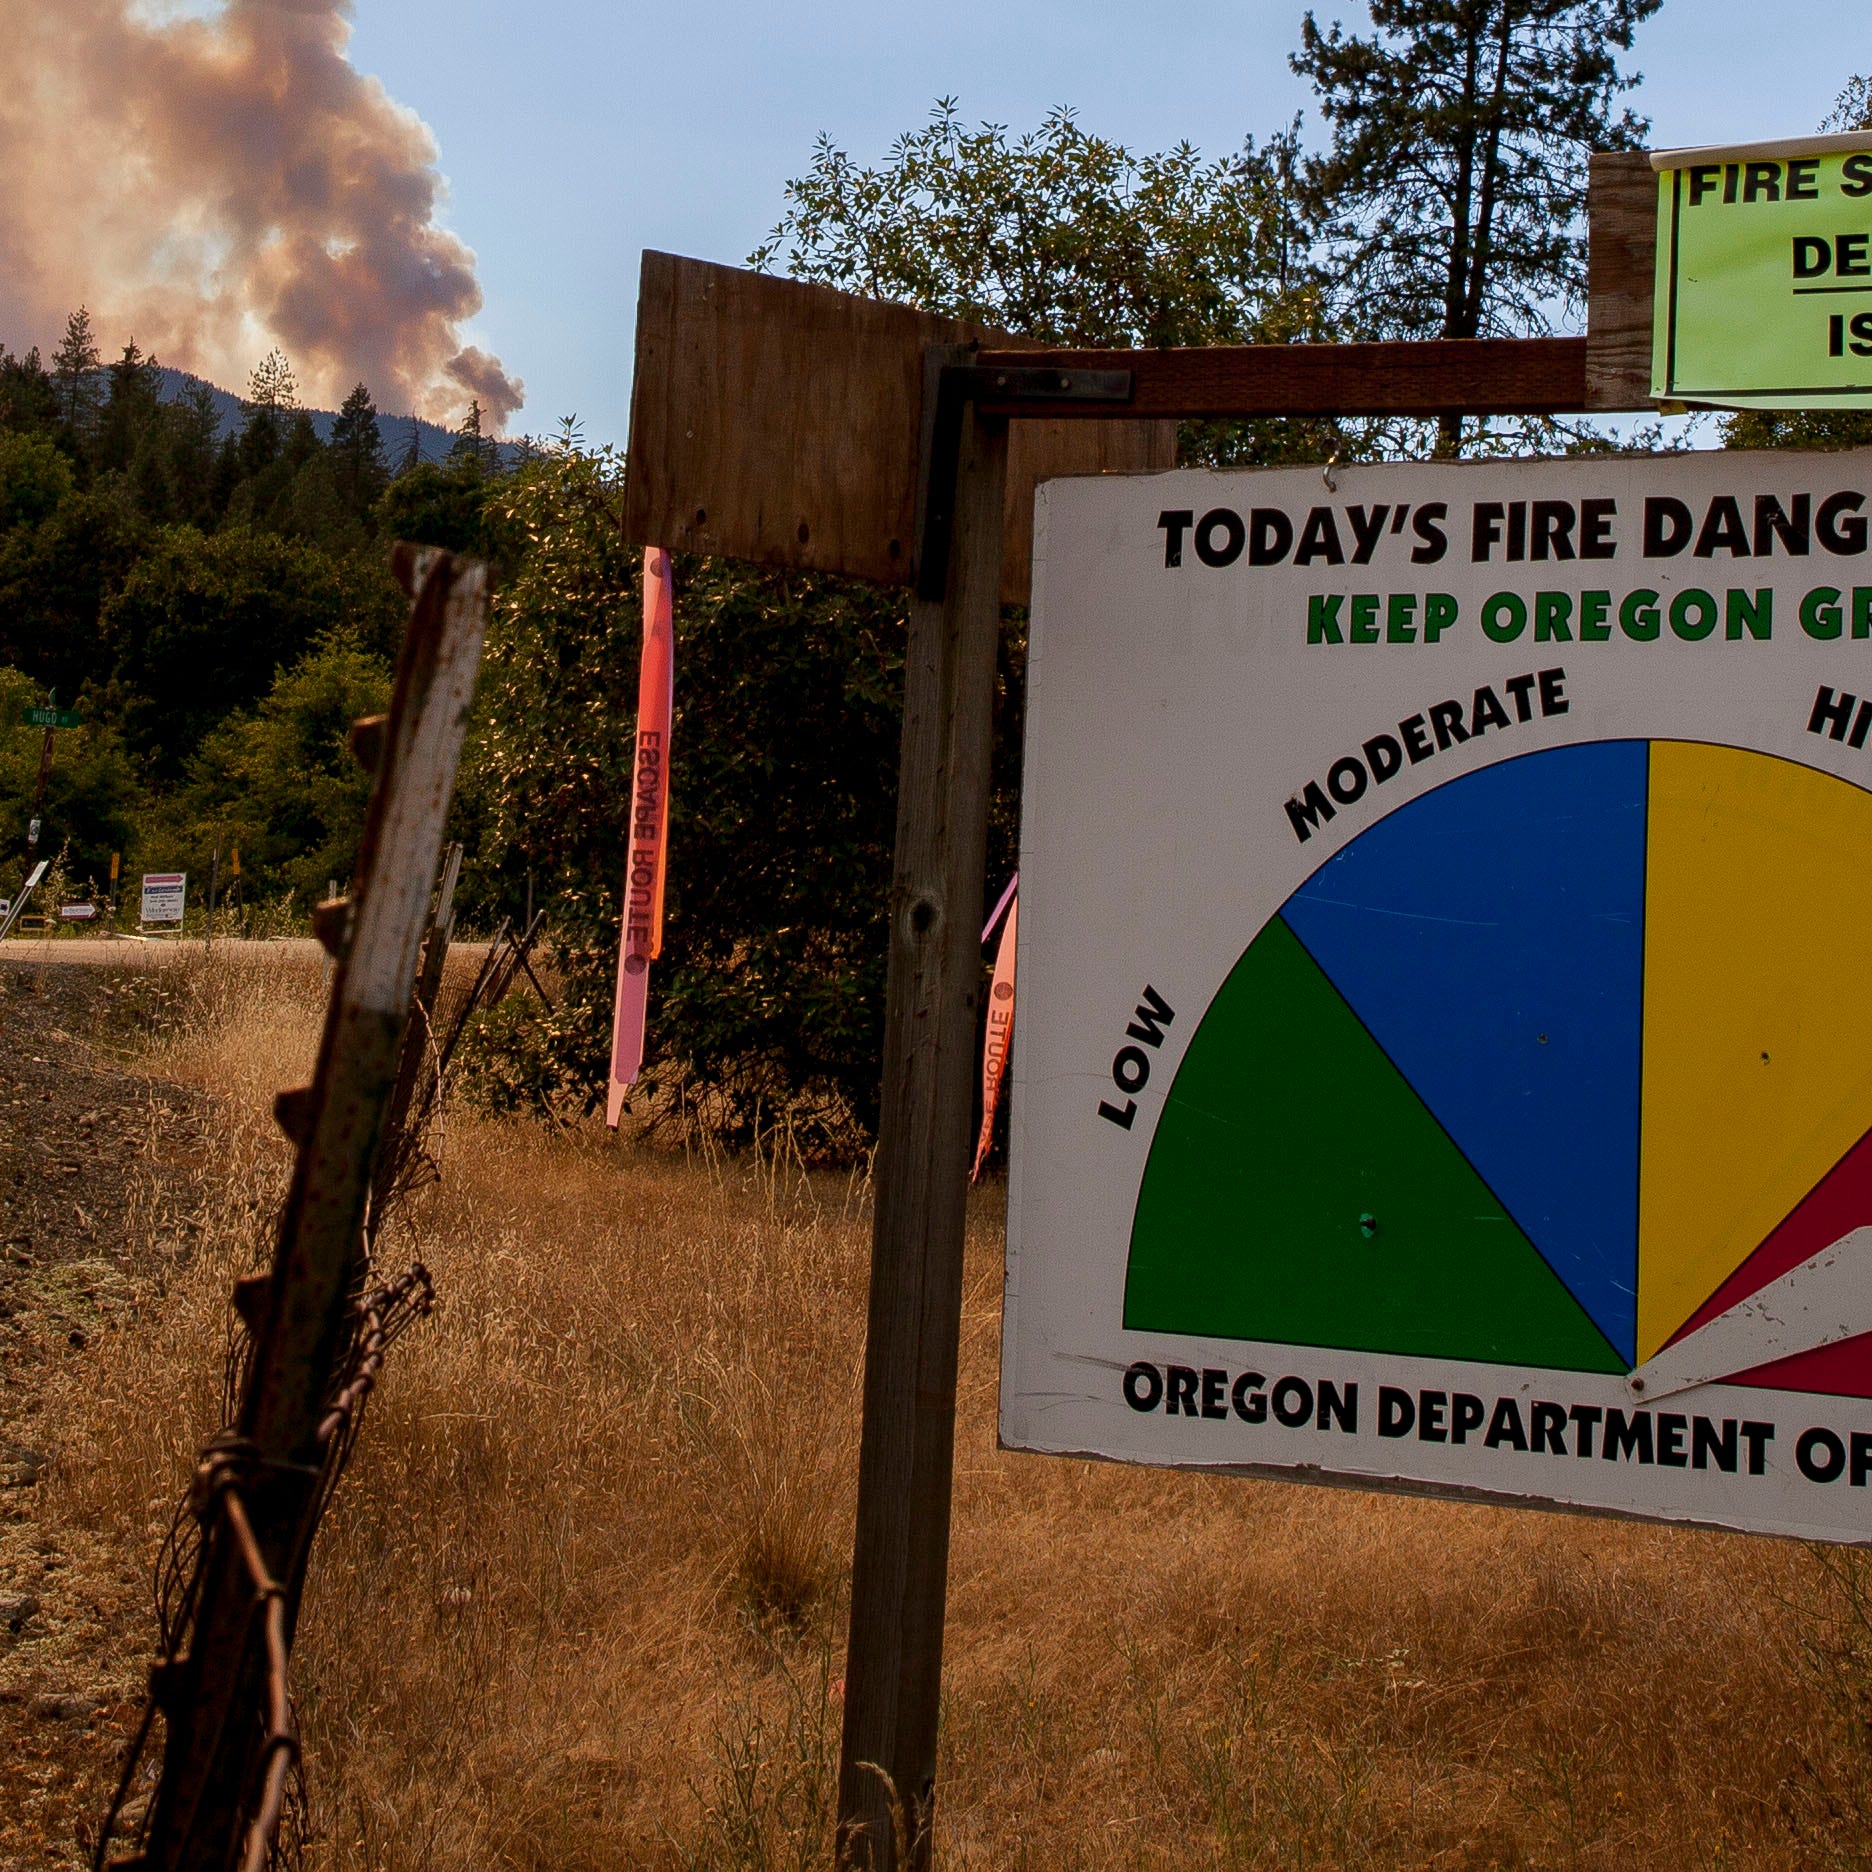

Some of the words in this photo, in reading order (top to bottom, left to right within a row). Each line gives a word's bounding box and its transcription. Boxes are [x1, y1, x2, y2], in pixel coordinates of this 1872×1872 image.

[1685, 159, 1821, 207] FIRE
[1157, 502, 1448, 569] TODAY'S
[1471, 498, 1618, 563] FIRE
[1306, 590, 1459, 645] KEEP
[1480, 586, 1774, 644] OREGON
[32, 709, 57, 725] HUGO
[1283, 666, 1570, 843] MODERATE
[1097, 984, 1176, 1132] LOW
[1122, 1361, 1359, 1434] OREGON
[1377, 1386, 1775, 1476] DEPARTMENT
